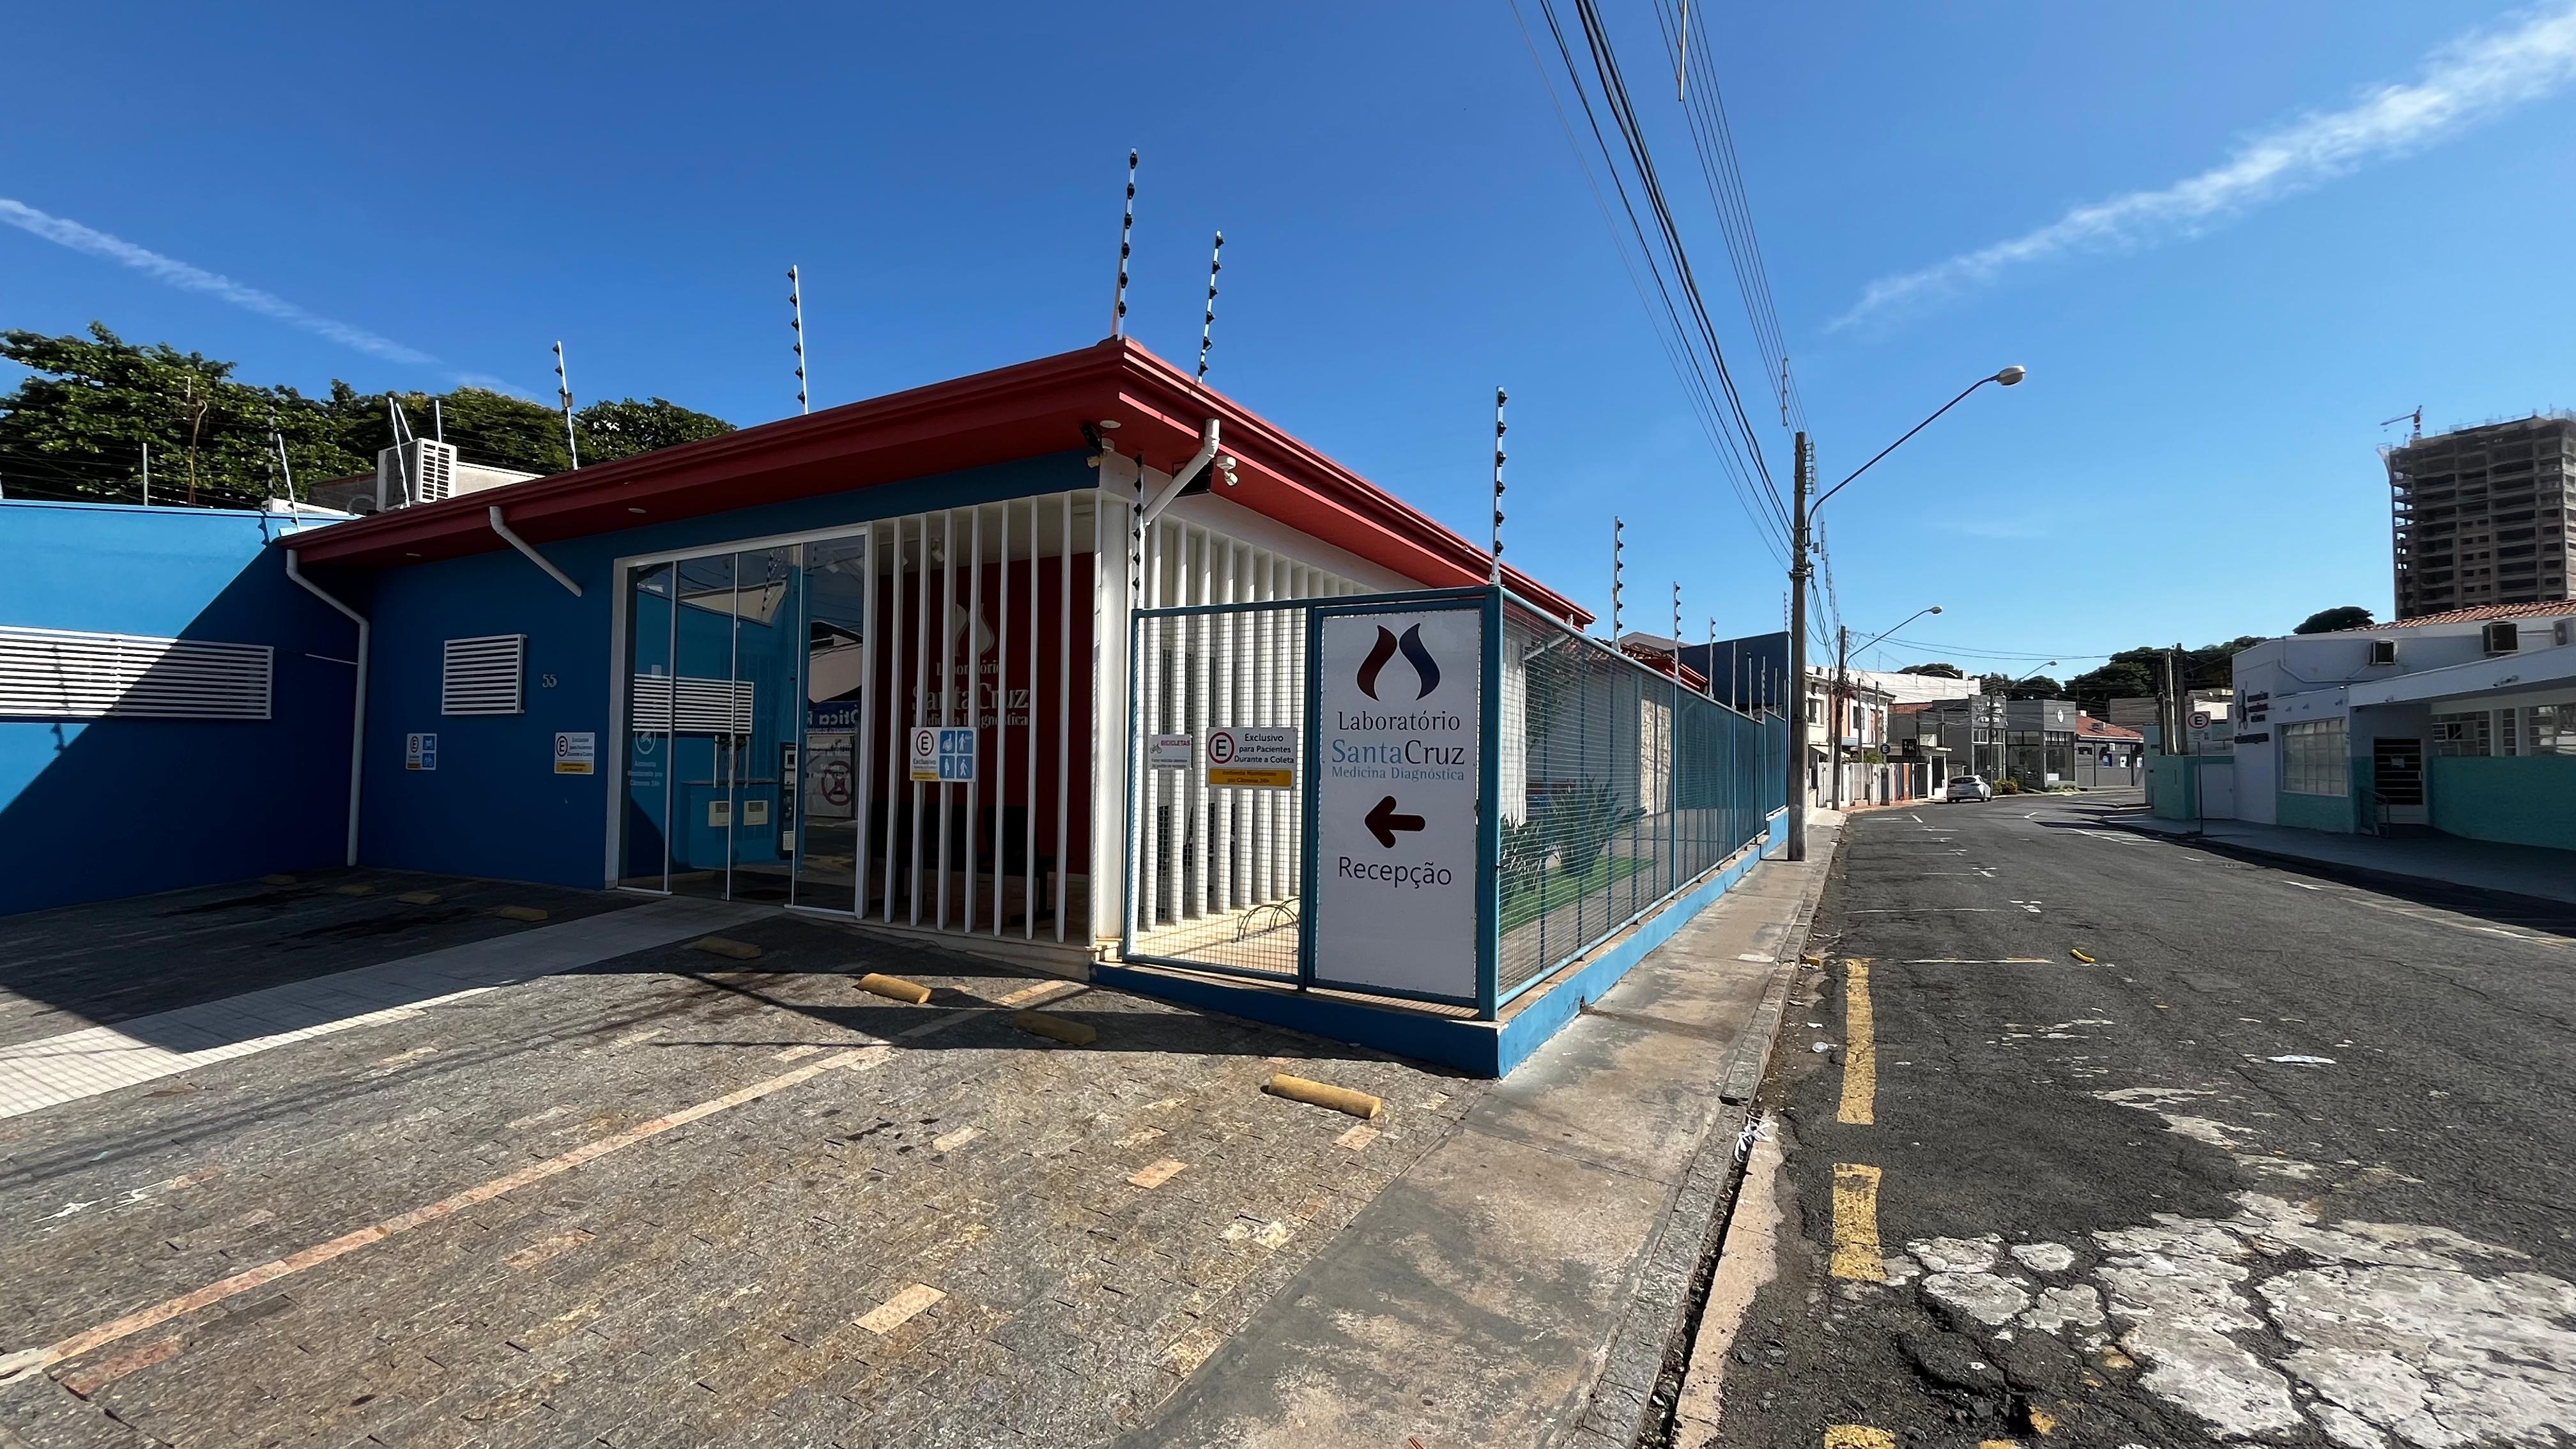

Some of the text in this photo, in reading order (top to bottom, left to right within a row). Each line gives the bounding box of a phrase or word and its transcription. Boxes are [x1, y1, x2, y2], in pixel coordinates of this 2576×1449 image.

[542, 673, 557, 688] 55
[1337, 710, 1460, 731] Laboratório
[2195, 716, 2202, 725] E
[921, 736, 928, 750] E
[1245, 733, 1284, 742] Exclusivo
[1216, 739, 1227, 756] E
[1256, 745, 1291, 753] Pacientes
[1332, 739, 1465, 765] SantaCruz
[1332, 766, 1464, 783] Medicina Diagnóstica
[1339, 856, 1452, 889] Recepção
